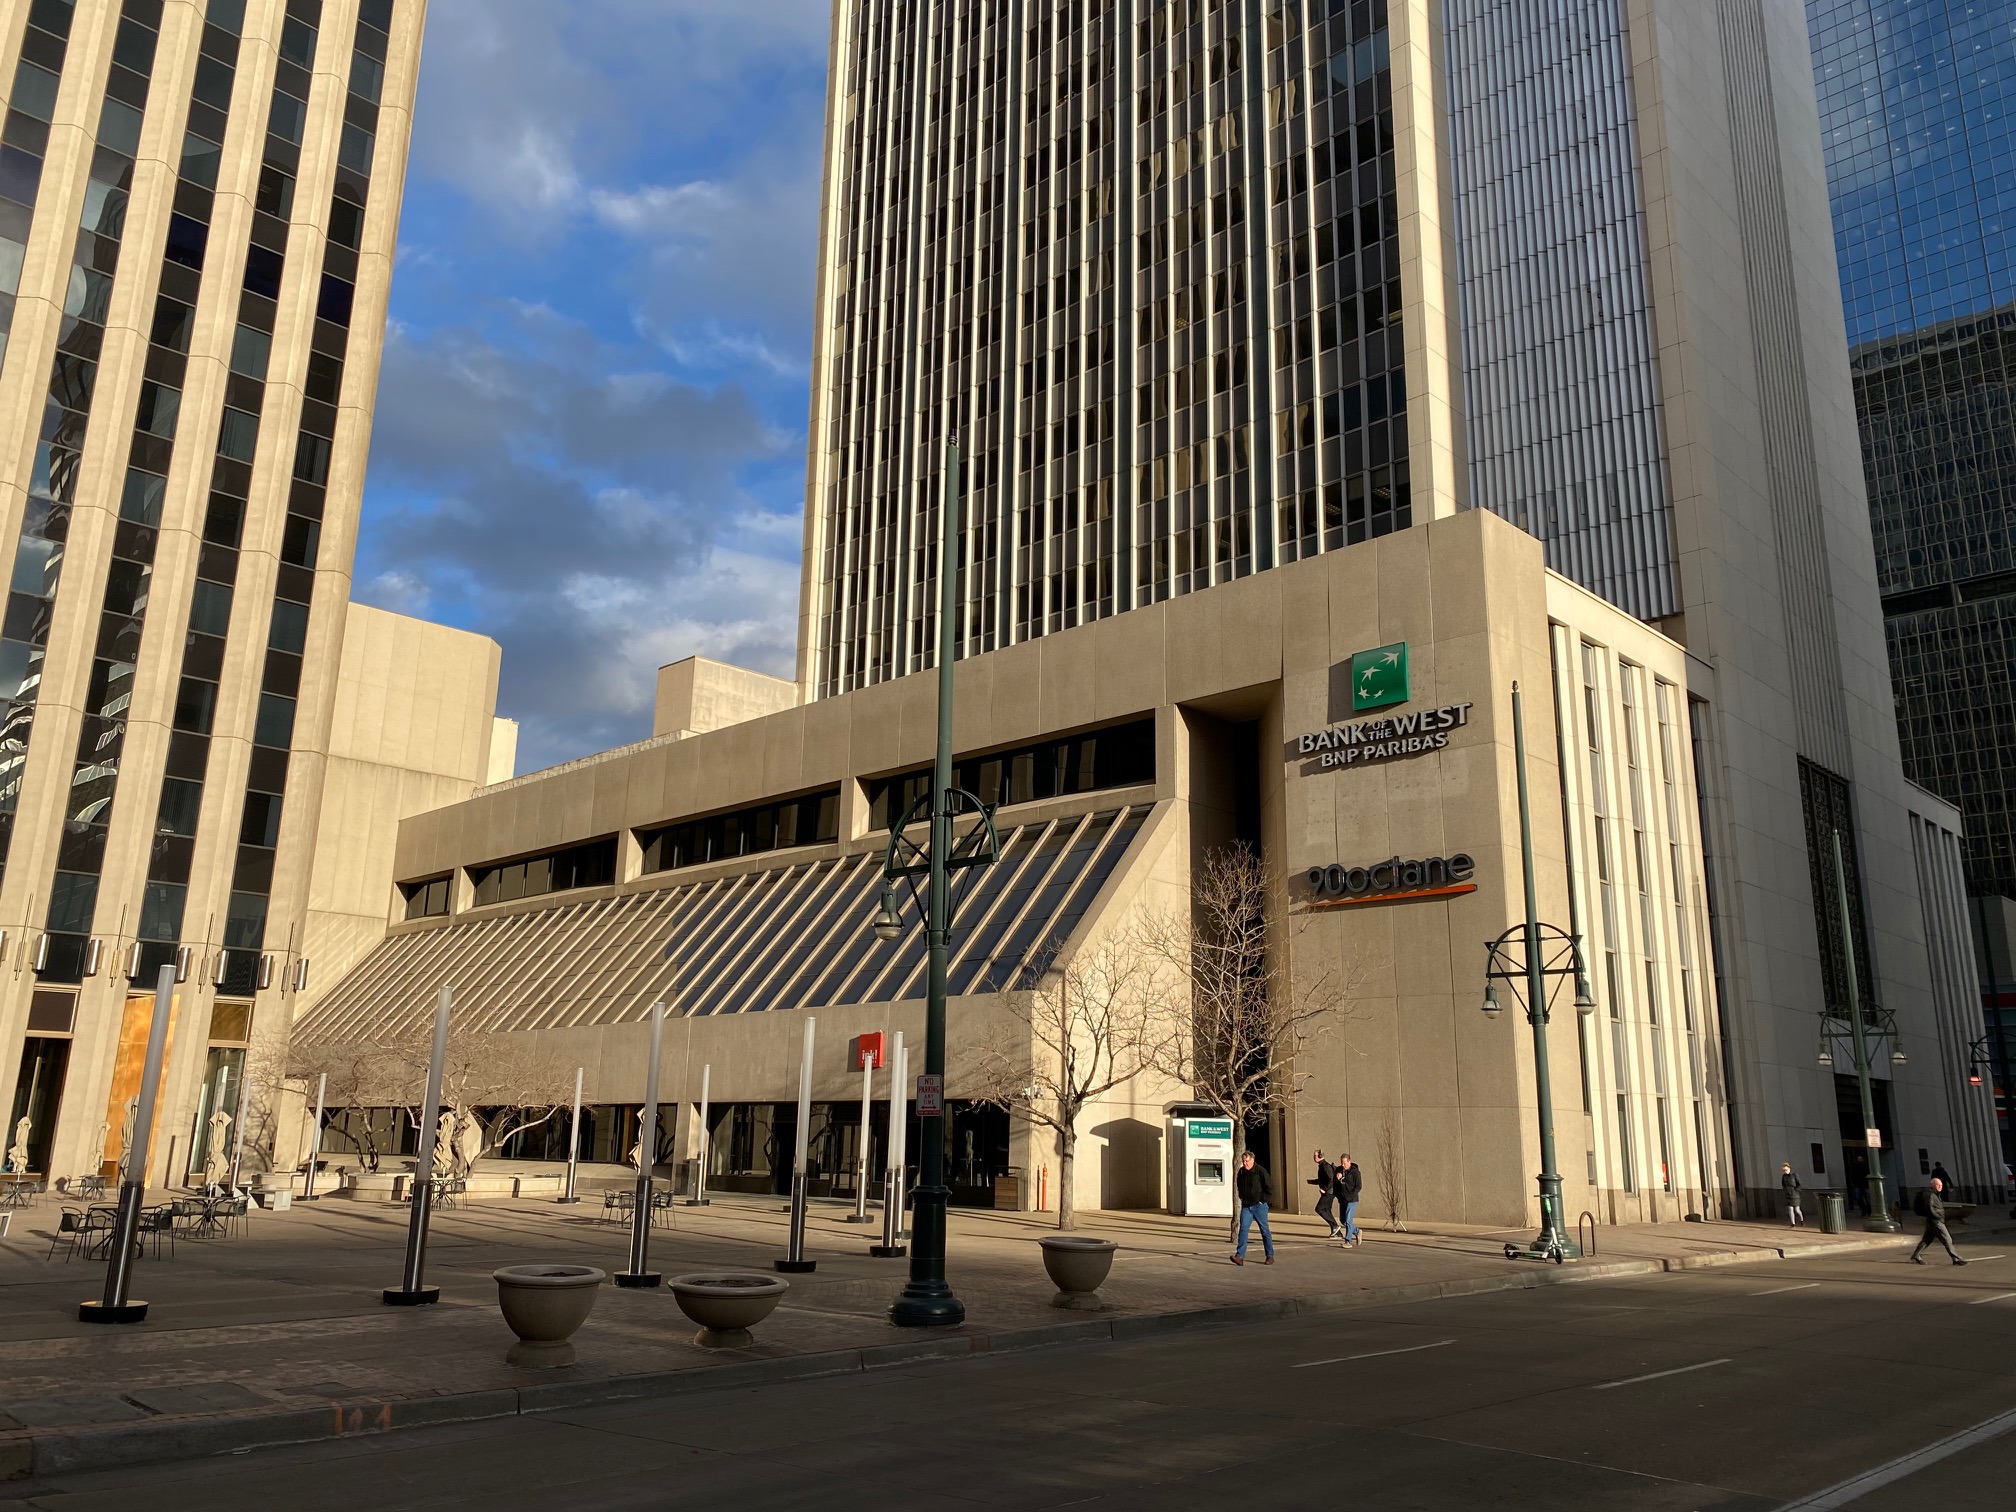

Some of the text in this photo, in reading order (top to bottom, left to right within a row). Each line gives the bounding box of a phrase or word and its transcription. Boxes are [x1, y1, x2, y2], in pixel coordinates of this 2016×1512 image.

[1299, 702, 1473, 754] BANK OF THE WEST
[1321, 732, 1449, 768] BNP PARIBAS
[1306, 853, 1476, 896] 90octane
[919, 1085, 939, 1093] PARKING
